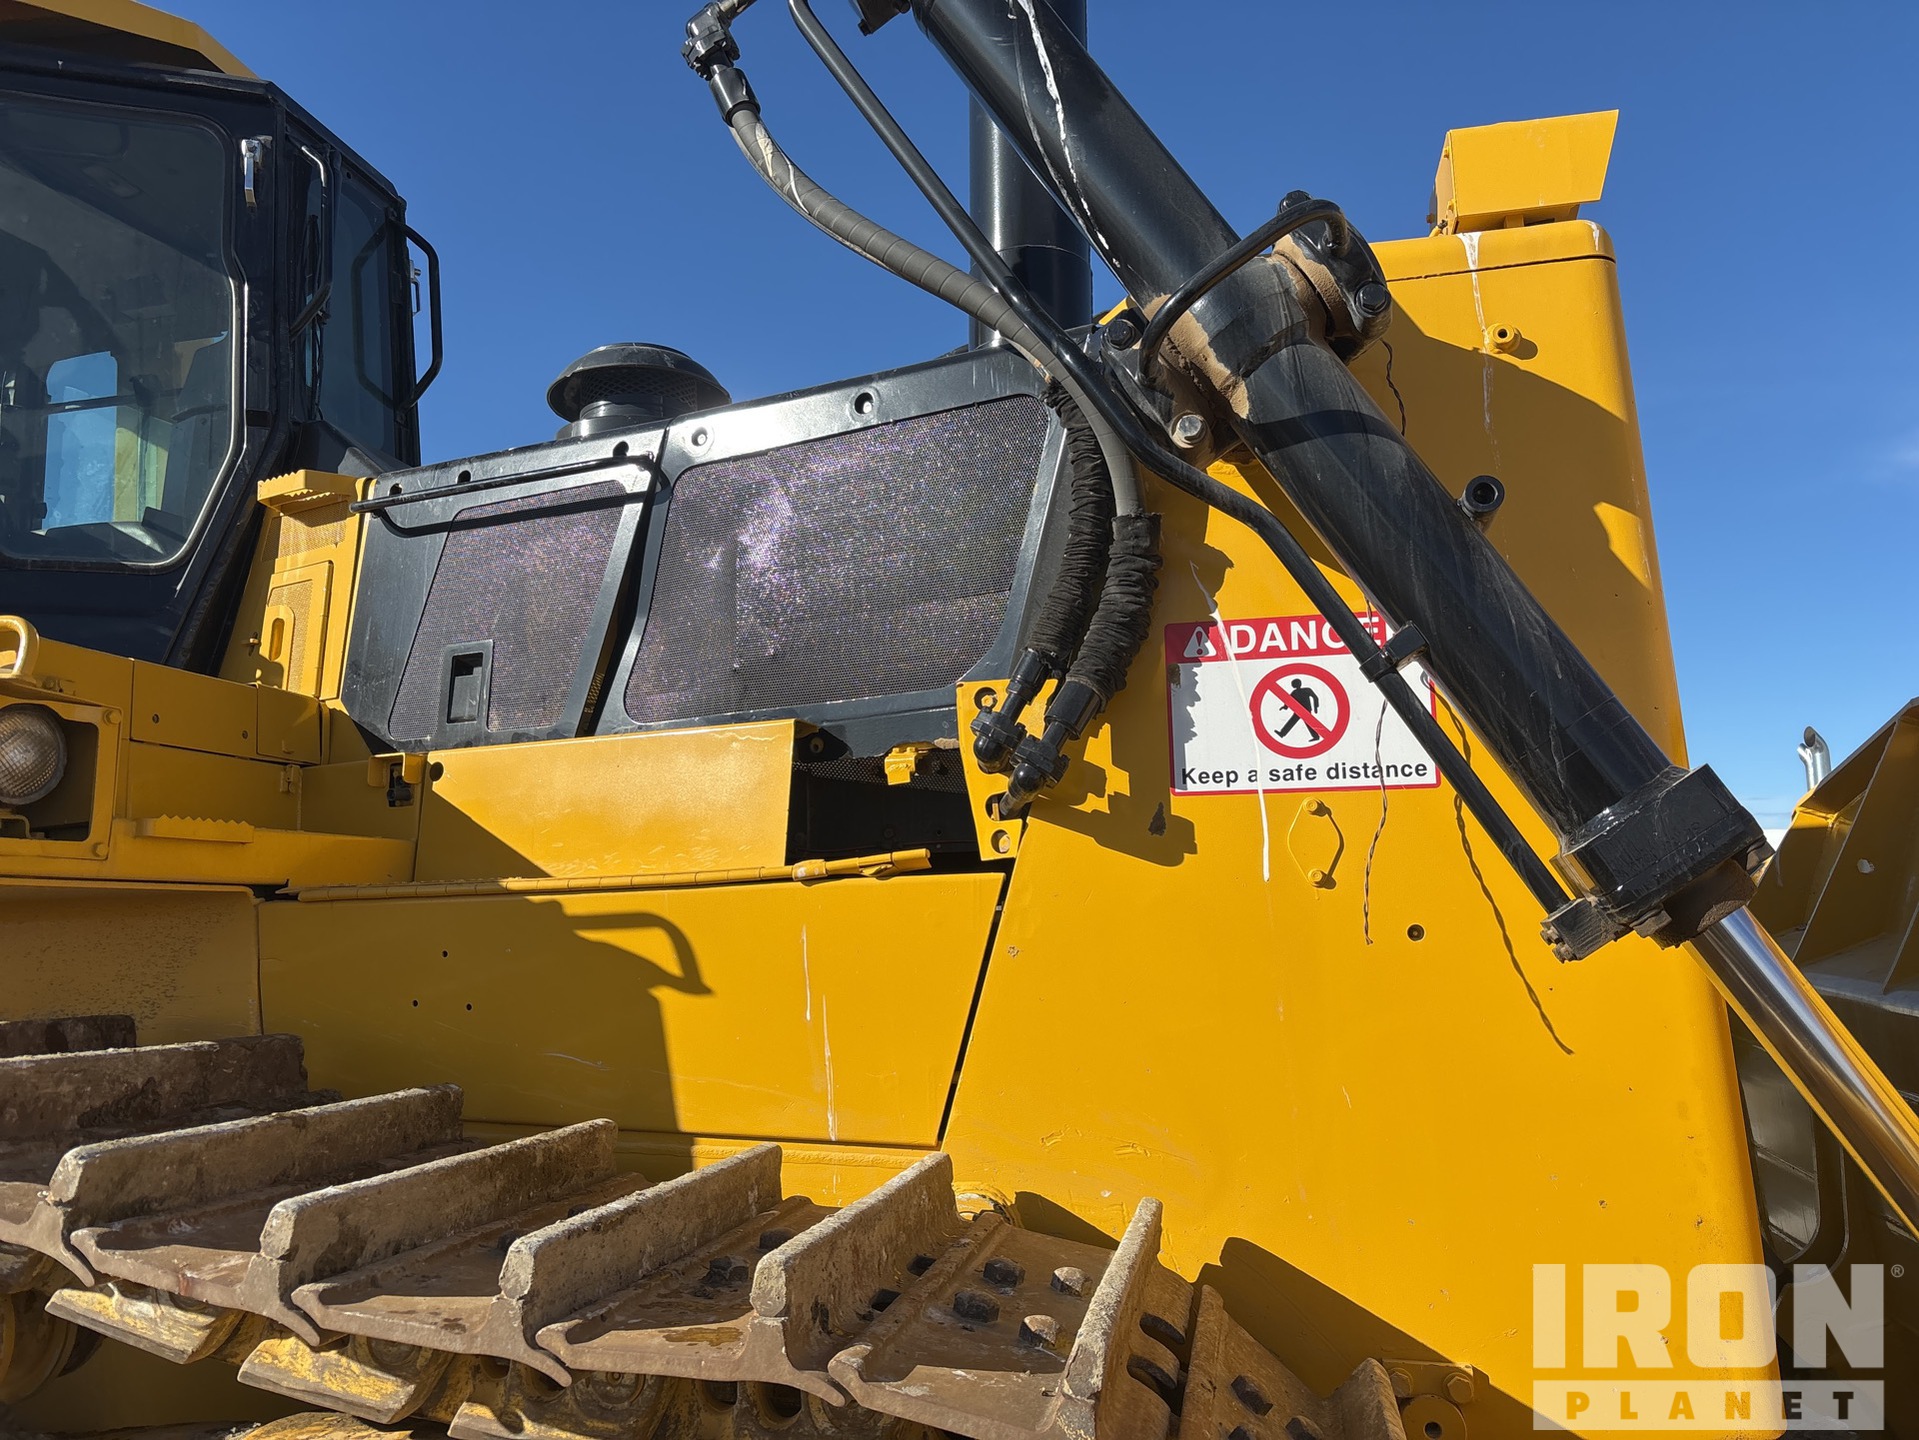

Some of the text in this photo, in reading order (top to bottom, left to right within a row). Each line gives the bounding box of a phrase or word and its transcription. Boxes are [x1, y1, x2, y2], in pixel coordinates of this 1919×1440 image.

[1230, 616, 1398, 654] DANGE
[1181, 762, 1428, 788] Keep a safe distance
